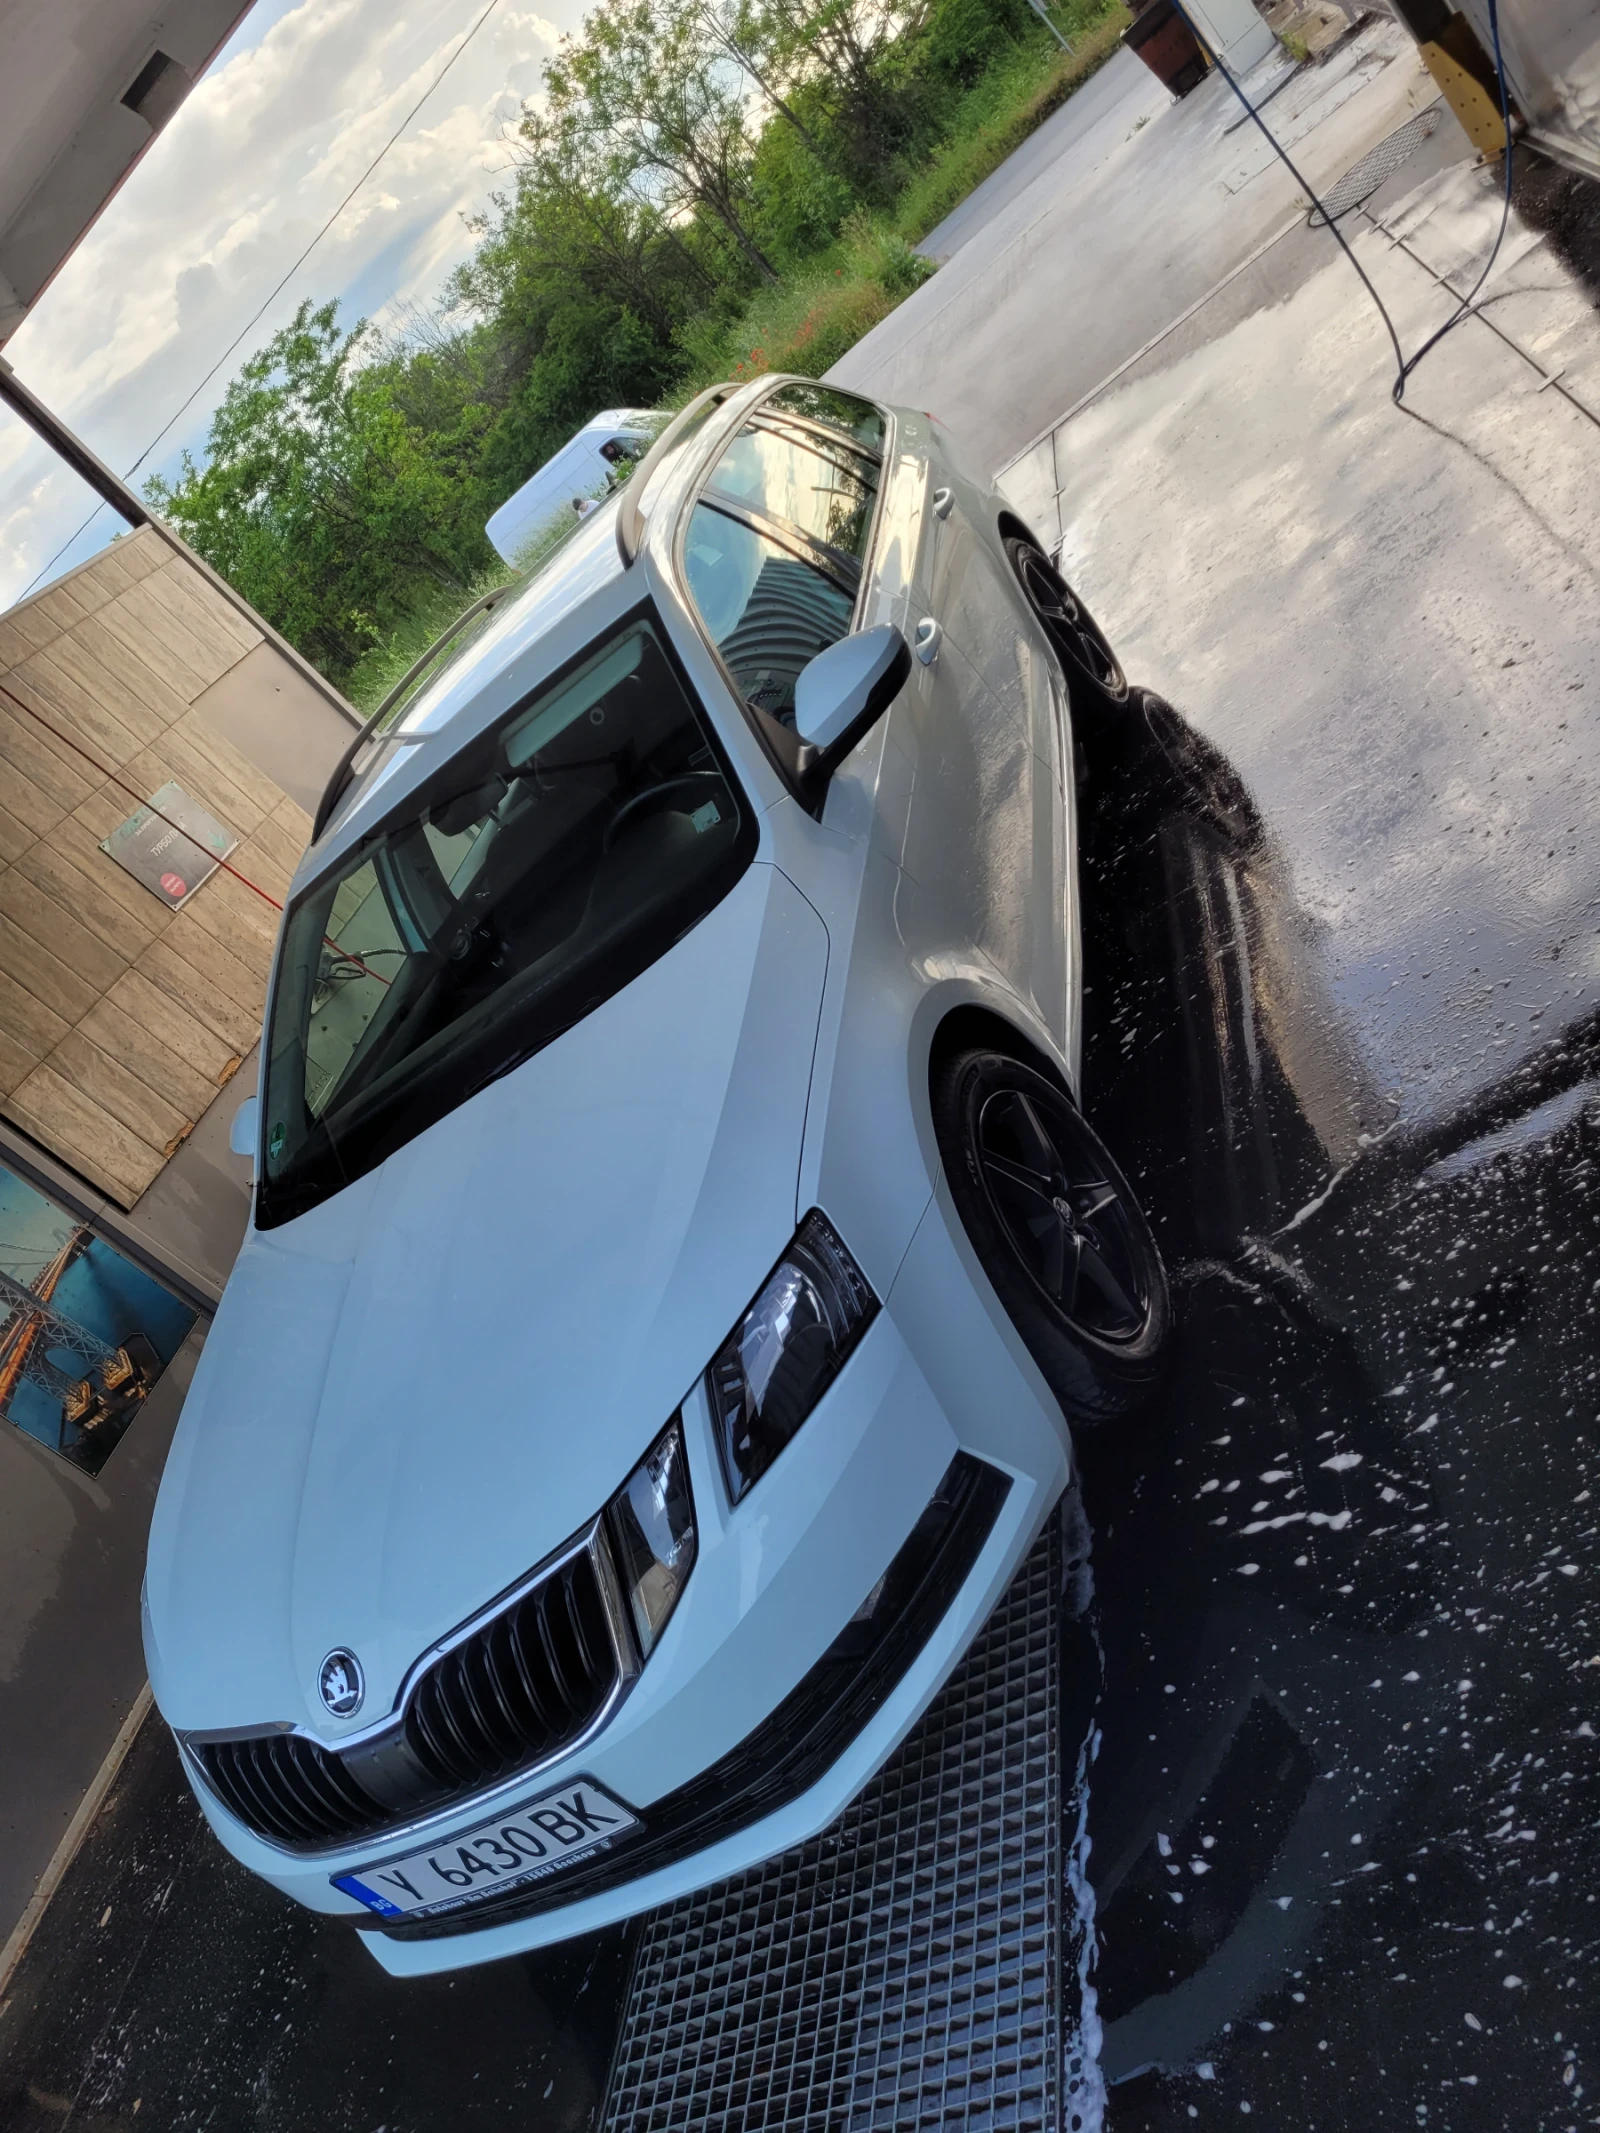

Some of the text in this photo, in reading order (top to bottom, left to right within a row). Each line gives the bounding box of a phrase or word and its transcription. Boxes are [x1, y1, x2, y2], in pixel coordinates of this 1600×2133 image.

[150, 834, 173, 857] ТУРБО
[427, 1827, 548, 1886] 6430
[370, 1899, 392, 1910] BG
